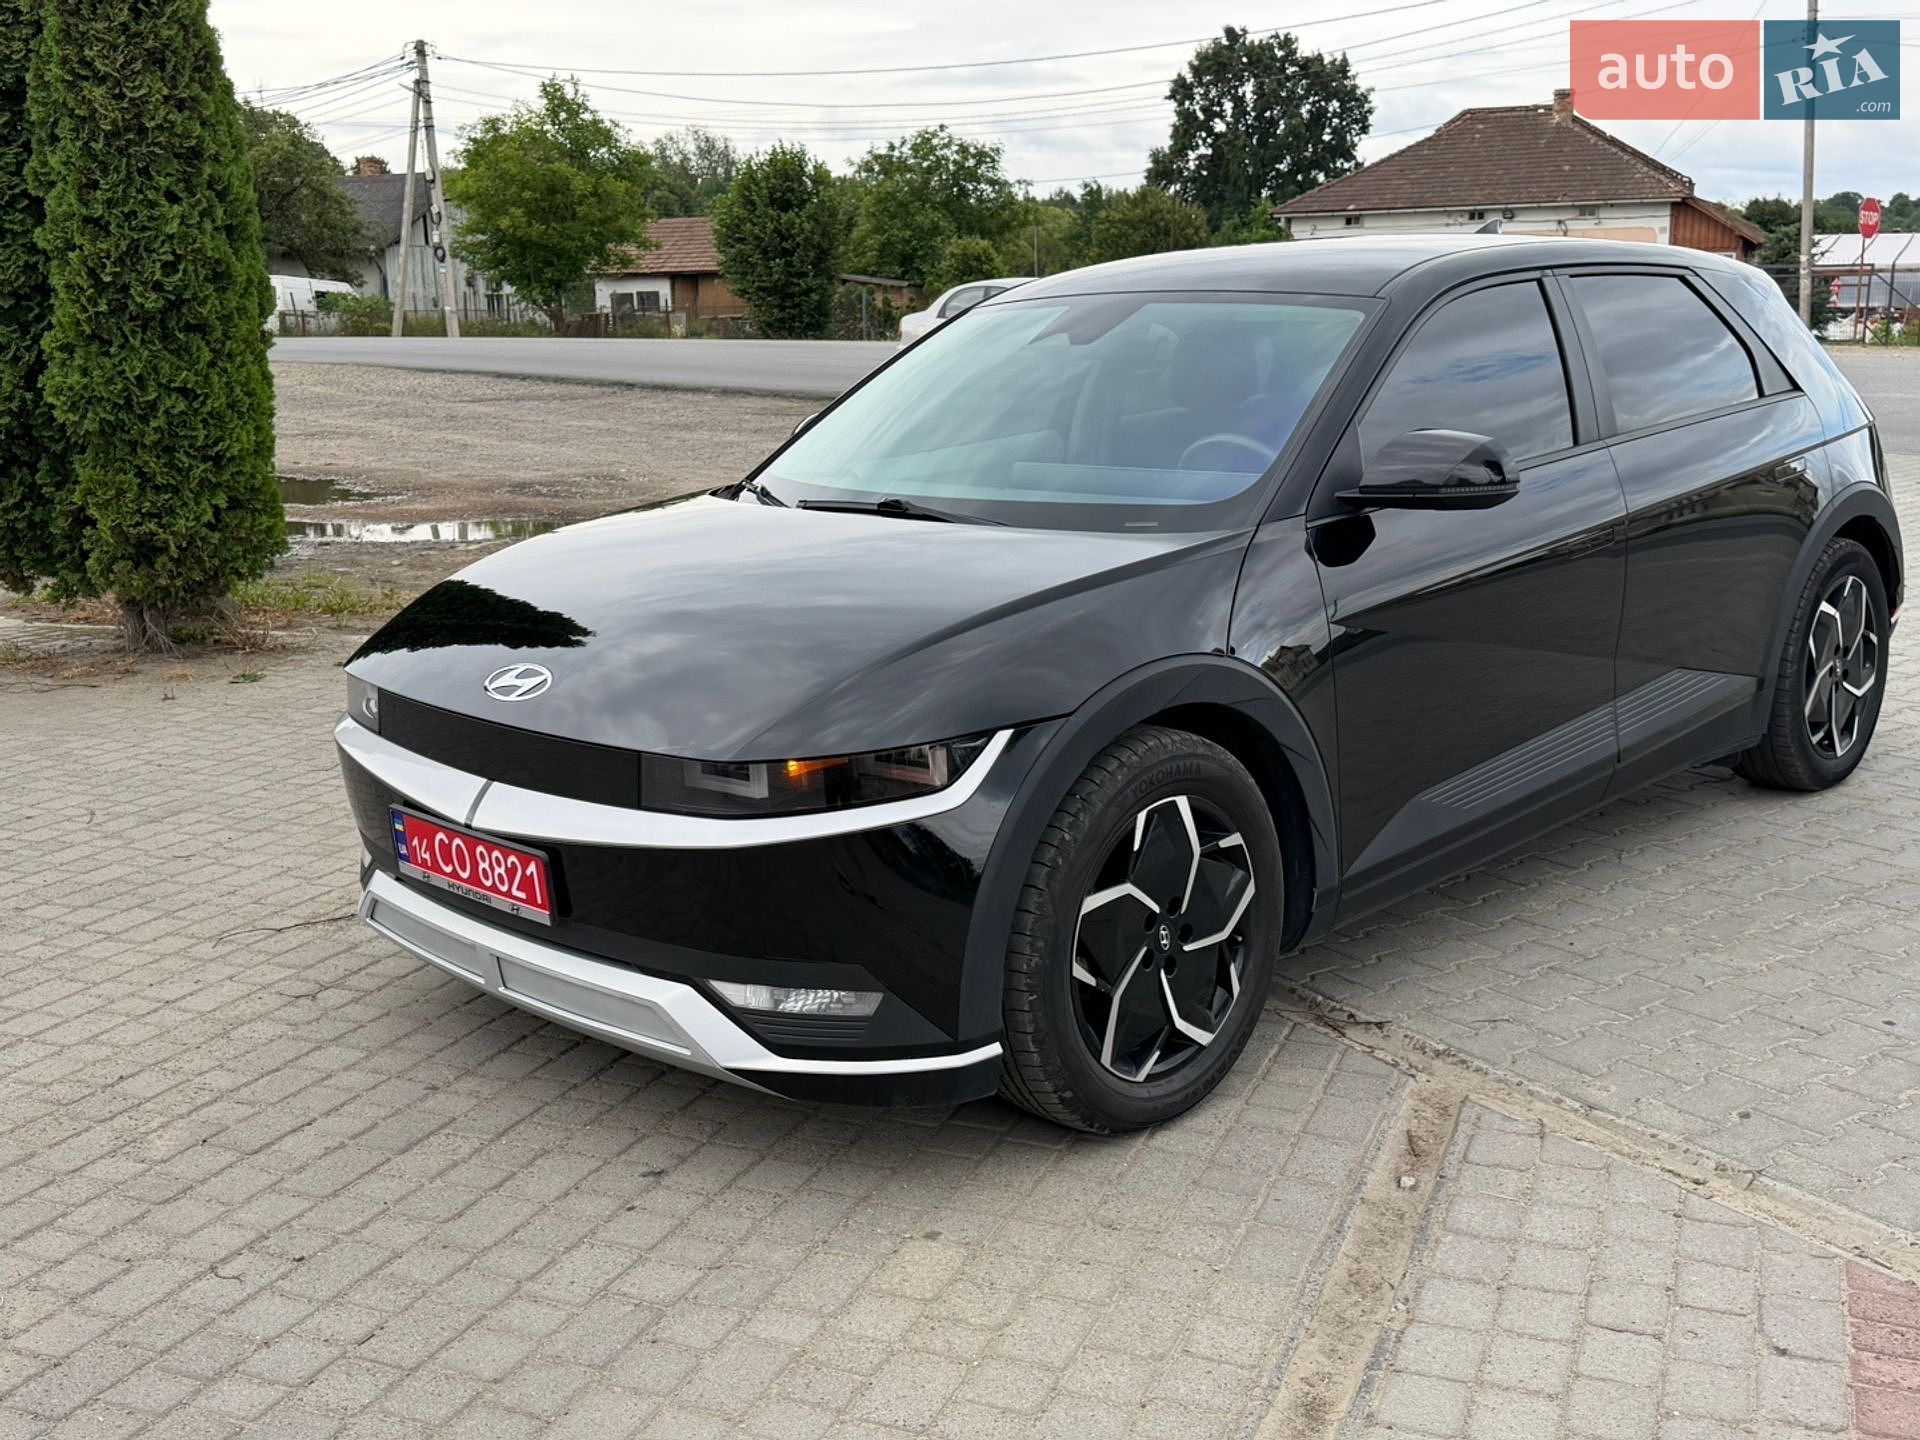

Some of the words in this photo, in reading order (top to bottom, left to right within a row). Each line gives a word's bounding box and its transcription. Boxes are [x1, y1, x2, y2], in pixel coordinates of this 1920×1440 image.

[1860, 211, 1879, 225] STOP
[1130, 761, 1201, 798] YOKOHAMA
[412, 836, 432, 867] 14
[434, 832, 471, 880] CO
[475, 845, 543, 905] 8821
[447, 882, 492, 905] HYUNDAI
